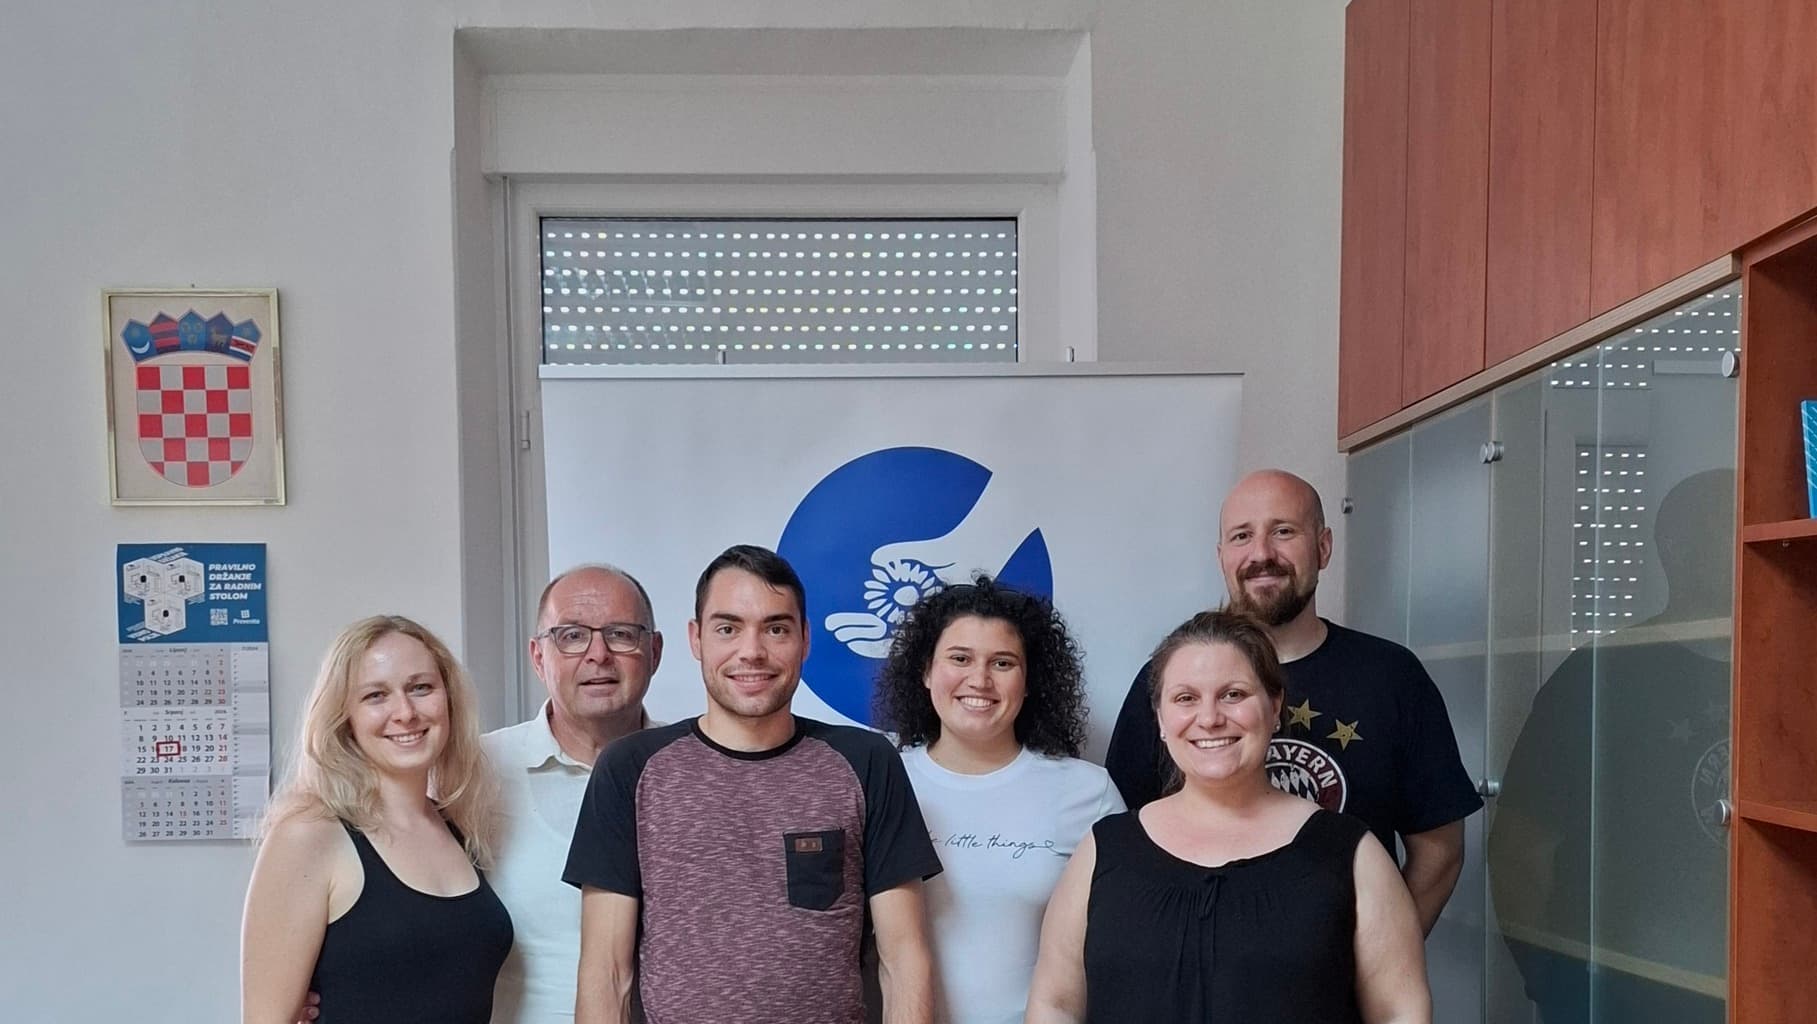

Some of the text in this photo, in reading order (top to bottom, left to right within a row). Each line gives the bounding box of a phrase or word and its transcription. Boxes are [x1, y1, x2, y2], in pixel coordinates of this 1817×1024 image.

[208, 563, 256, 571] PRAVILNO
[208, 571, 252, 581] DRŽANJE
[208, 582, 262, 590] ZA RADNIM
[208, 592, 248, 600] STOLOM
[1266, 744, 1338, 788] AYERN
[945, 833, 983, 849] little
[986, 832, 1038, 859] things
